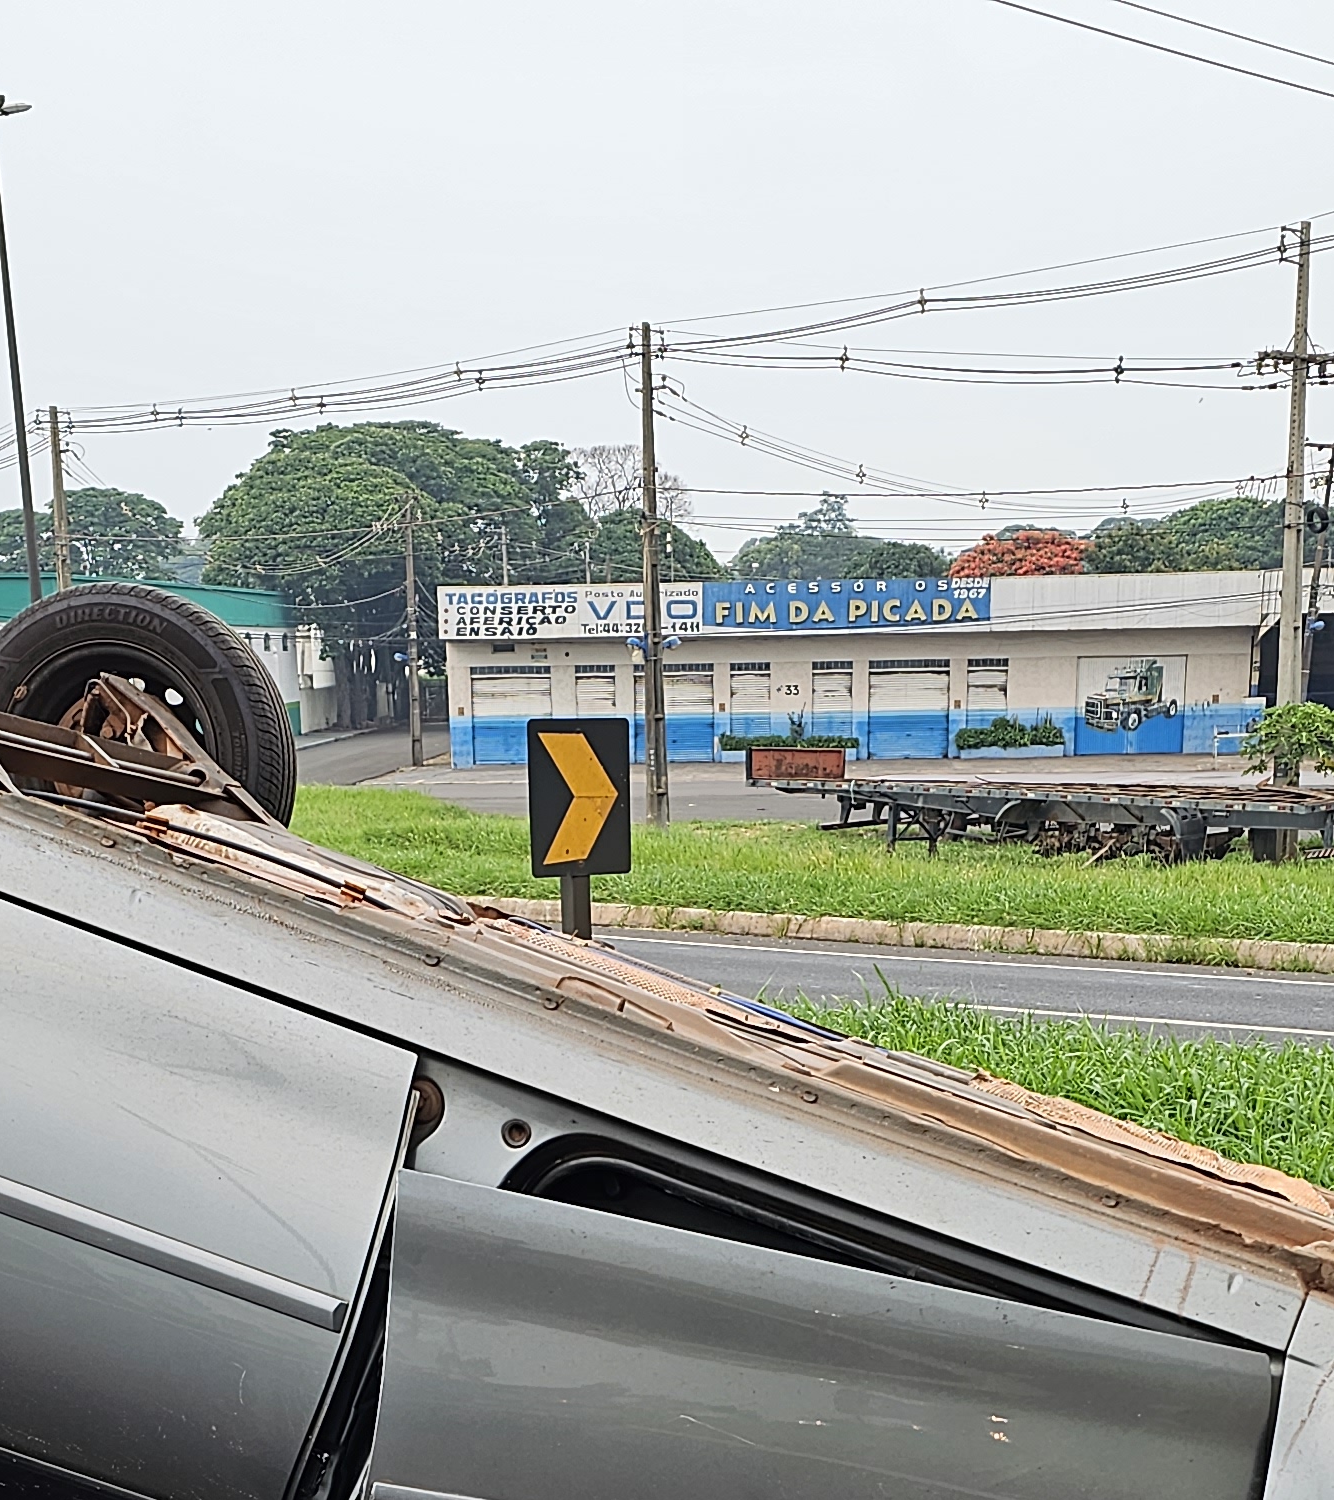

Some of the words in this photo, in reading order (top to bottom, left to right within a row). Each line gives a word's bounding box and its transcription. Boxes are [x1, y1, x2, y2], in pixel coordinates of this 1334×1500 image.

[745, 579, 948, 594] ACESSÓROS
[951, 577, 990, 588] DESDE
[445, 589, 578, 606] TACÓGRAFOS
[585, 590, 624, 598] Posto
[953, 589, 987, 599] 1967
[456, 604, 577, 615] CONSERTO
[715, 600, 777, 624] FIM
[789, 600, 835, 623] DA
[848, 597, 979, 622] PICADA
[55, 604, 167, 634] DIRECTION
[455, 613, 567, 627] AFERIÇÃO
[784, 684, 800, 696] 33
